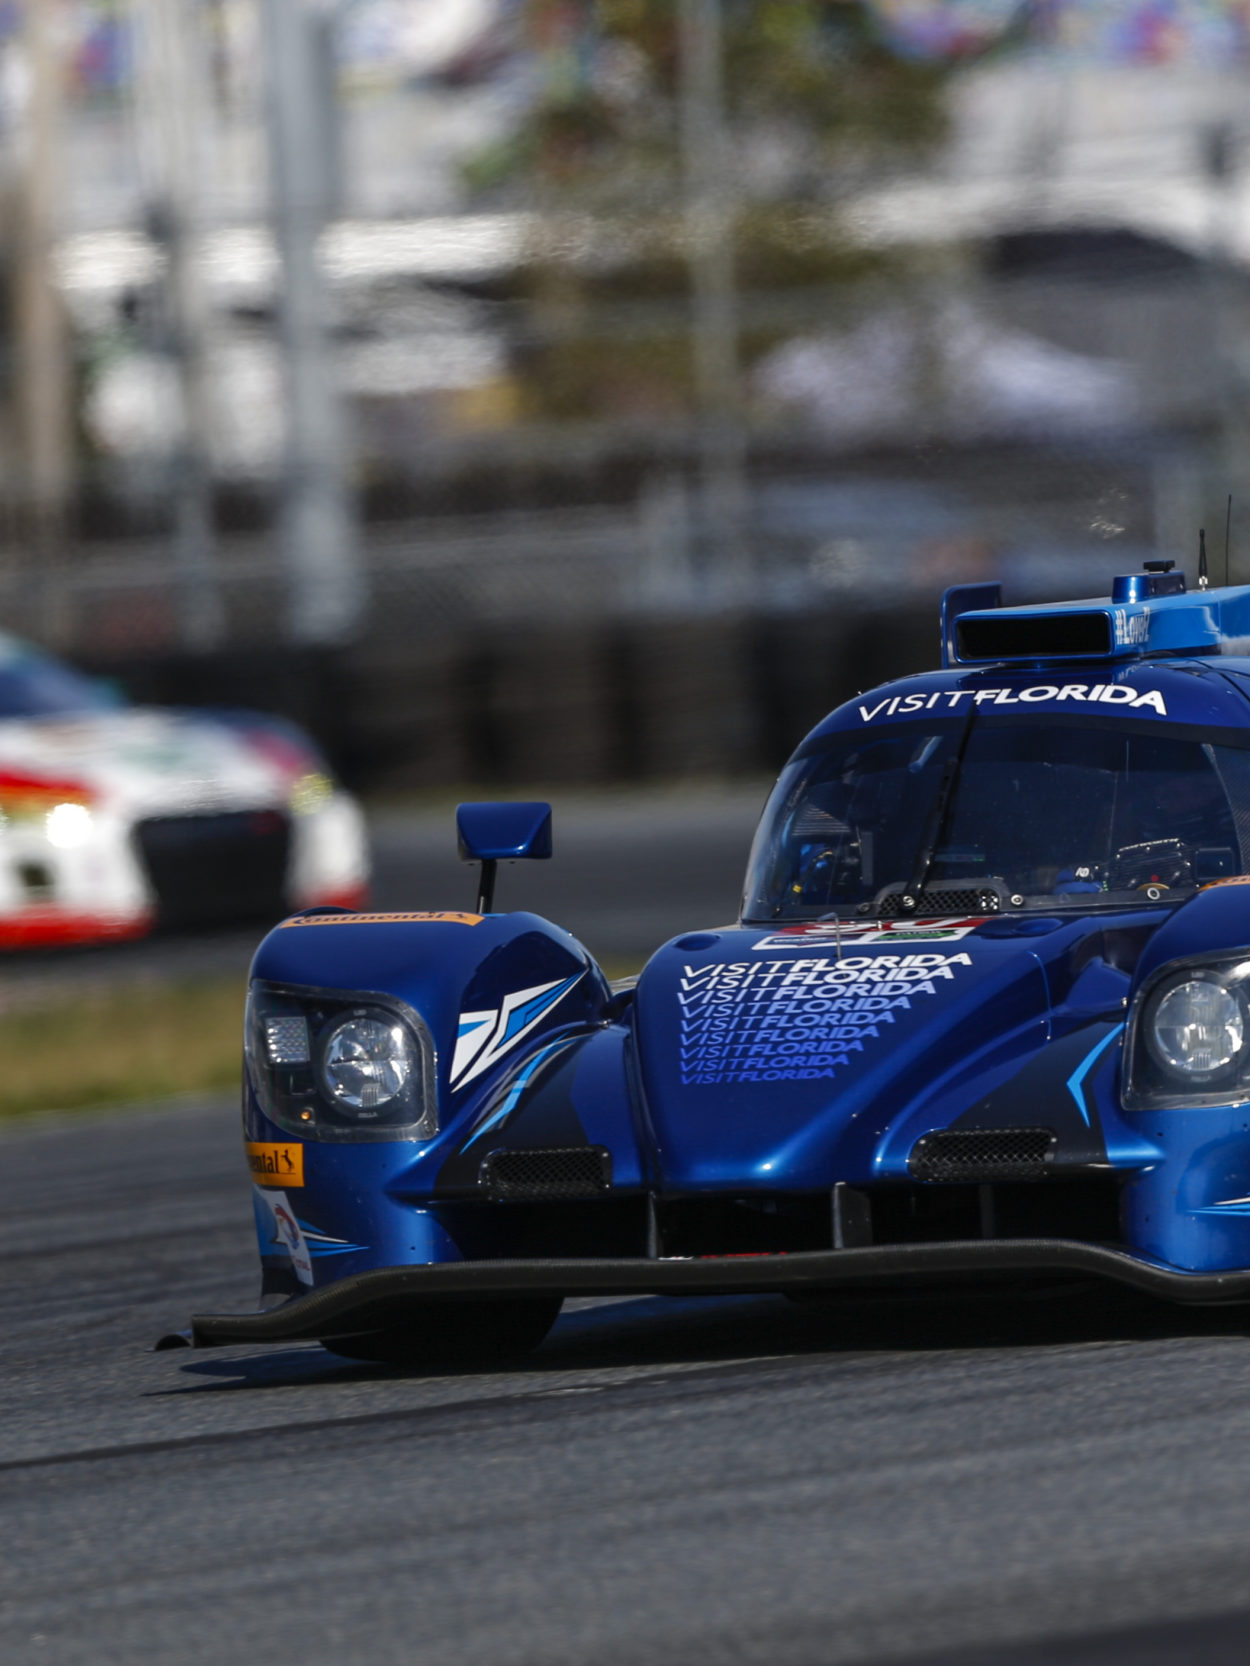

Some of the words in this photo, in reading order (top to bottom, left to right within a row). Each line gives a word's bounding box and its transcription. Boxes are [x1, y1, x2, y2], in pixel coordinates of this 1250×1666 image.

[684, 952, 973, 978] VISITFLORIDA
[680, 965, 954, 991] VISITFLORIDA
[677, 980, 936, 1005] VISITFLORIDA
[681, 995, 911, 1018] VISITFLORIDA
[681, 1010, 896, 1032] VISITFLORIDA
[680, 1024, 880, 1046] VISITFLORIDA
[680, 1039, 864, 1060] VISITFLORIDA
